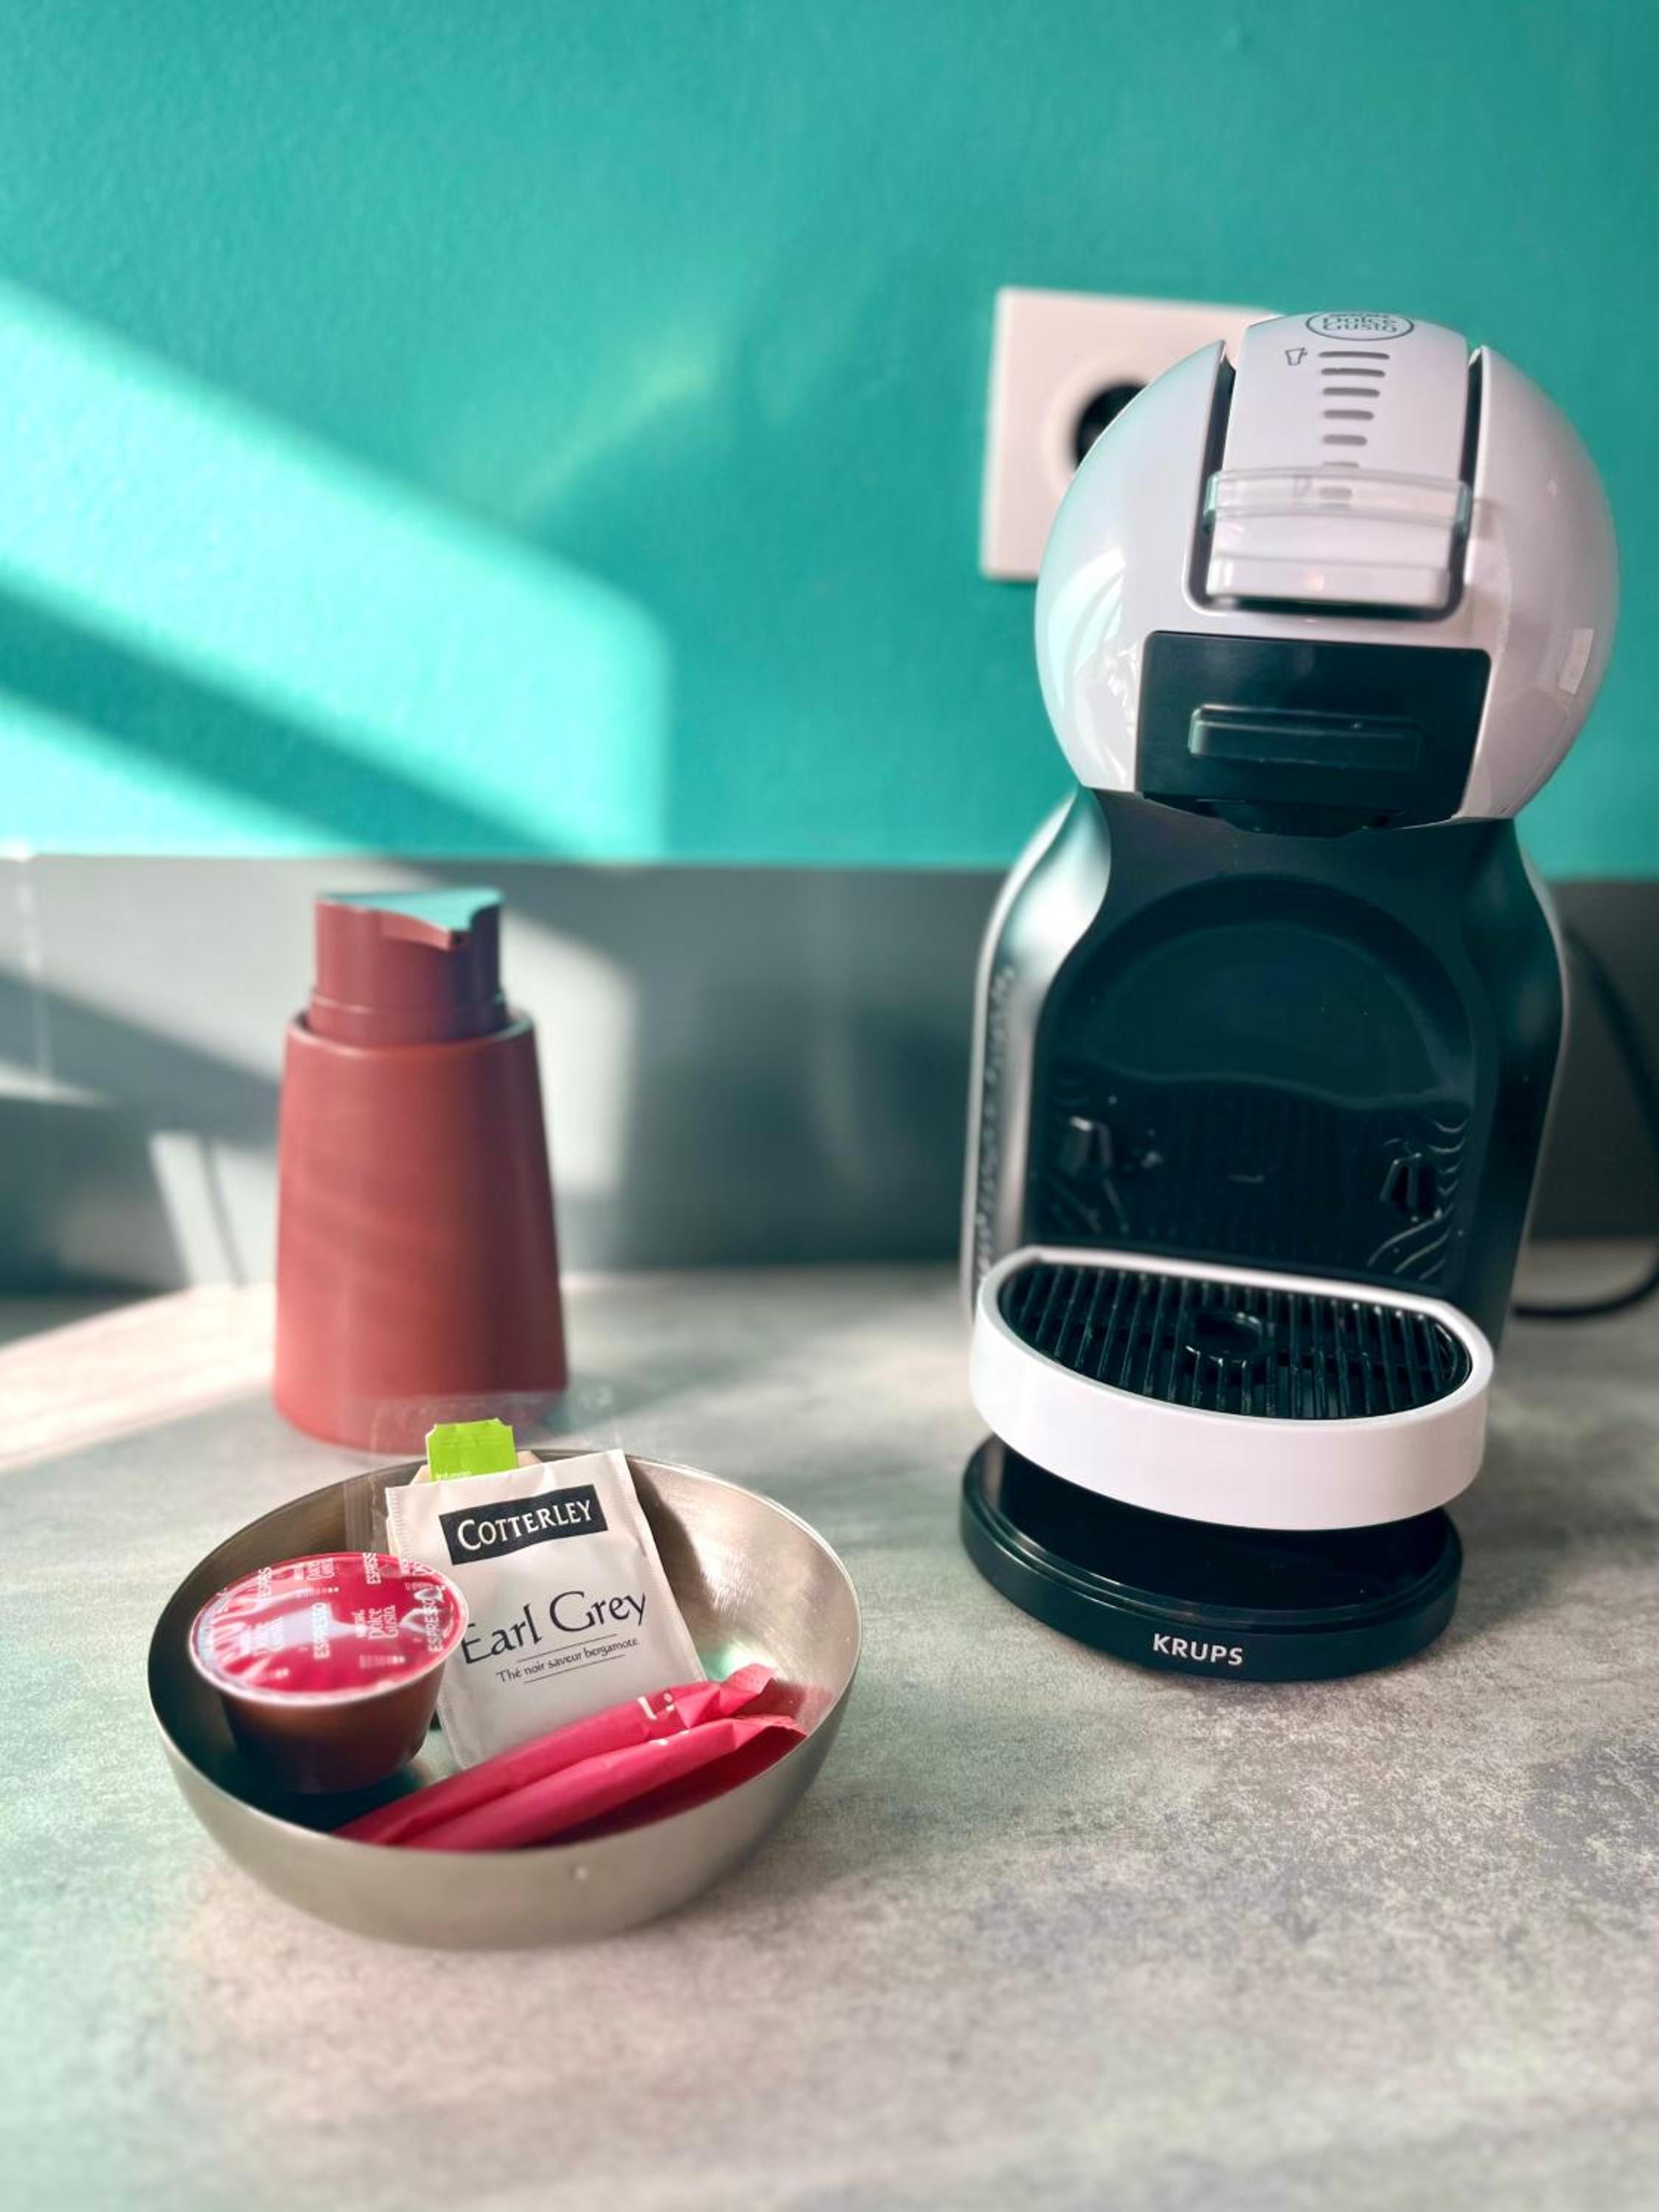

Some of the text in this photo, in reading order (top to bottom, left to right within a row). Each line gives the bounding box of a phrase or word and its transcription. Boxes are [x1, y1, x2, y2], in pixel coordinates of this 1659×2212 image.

[456, 1499, 593, 1551] COTTERLEY
[462, 1590, 647, 1664] Earl Grey
[1152, 1632, 1243, 1666] KRUPS
[524, 1660, 545, 1675] noir
[548, 1653, 582, 1669] saveur
[583, 1638, 639, 1658] bergamote
